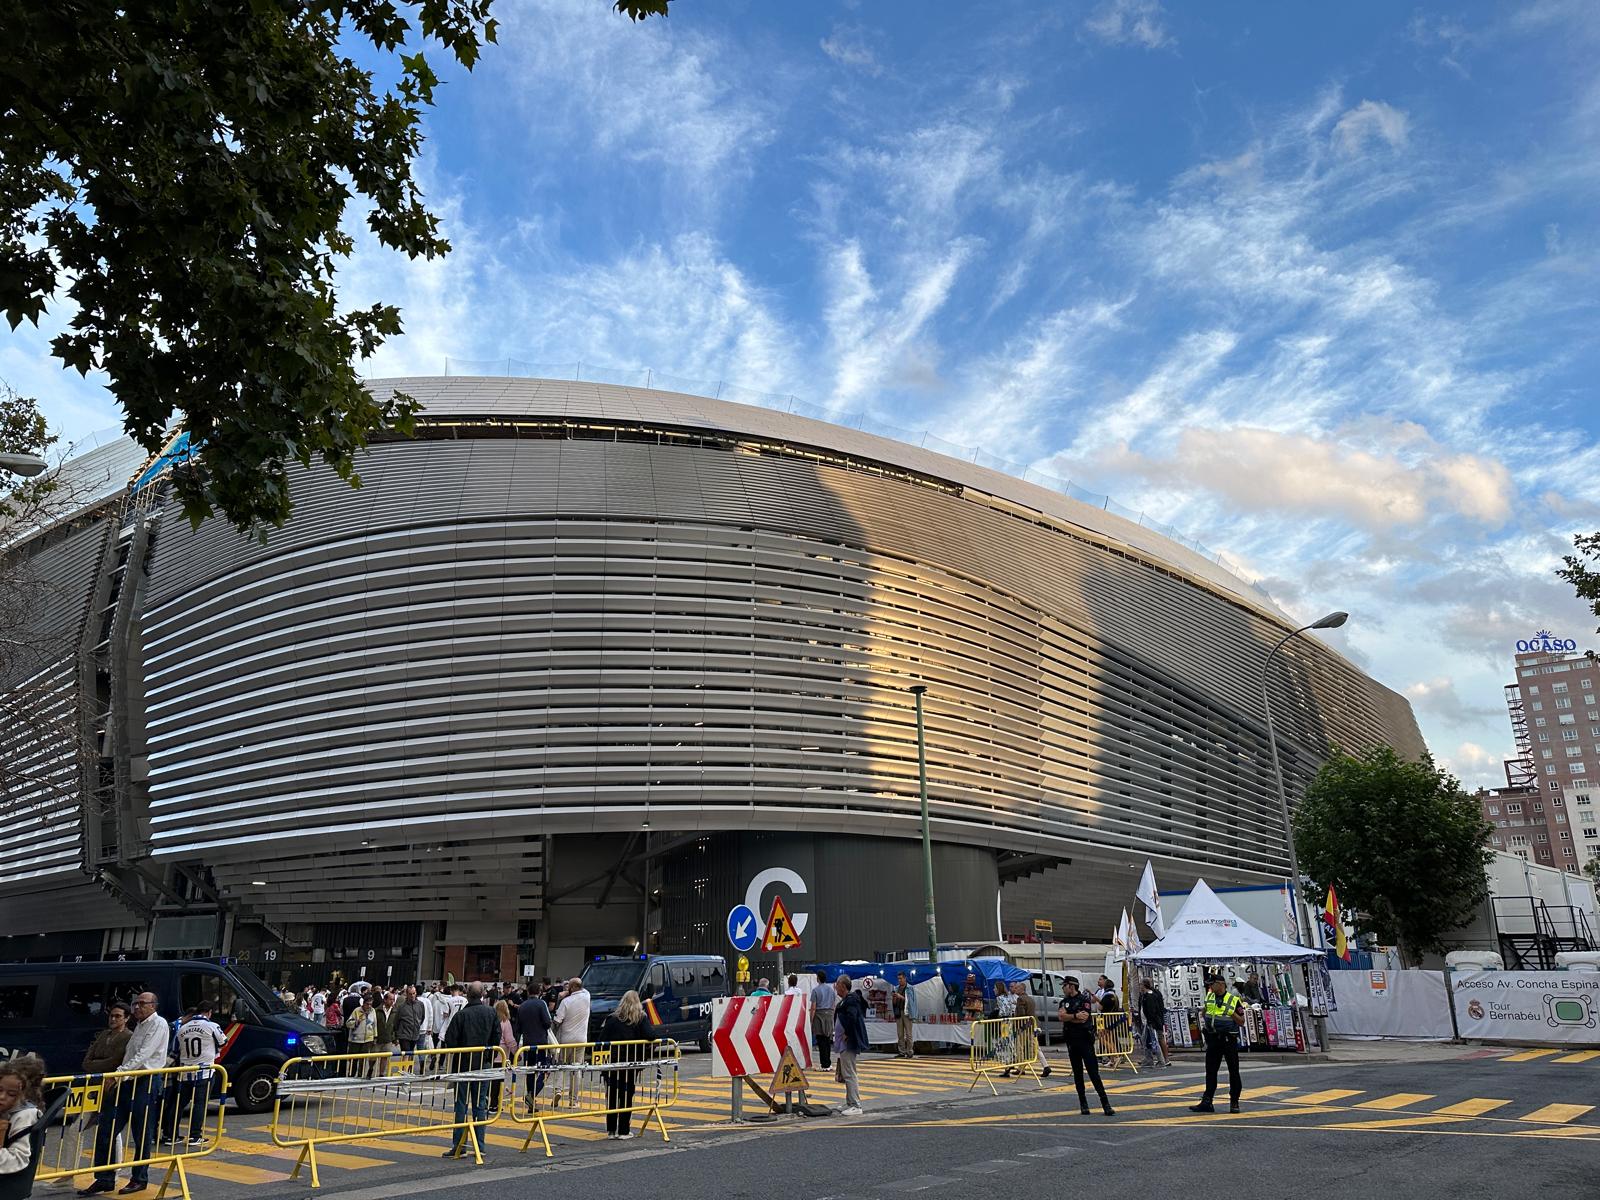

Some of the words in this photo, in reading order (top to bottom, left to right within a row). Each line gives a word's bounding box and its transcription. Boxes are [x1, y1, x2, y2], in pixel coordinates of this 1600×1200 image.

[1516, 639, 1577, 652] OCASO
[745, 867, 808, 942] C
[264, 950, 277, 961] 19
[367, 949, 375, 961] 9
[1169, 969, 1180, 979] 12
[1228, 966, 1236, 978] 5
[1188, 980, 1200, 991] 15
[1457, 980, 1494, 989] Acceso
[1497, 980, 1514, 989] Av.
[1516, 980, 1558, 989] Concha
[1561, 980, 1600, 991] Espina
[1488, 1001, 1511, 1011] Tour
[1489, 1011, 1541, 1021] Bernabéu
[184, 1037, 202, 1058] 10
